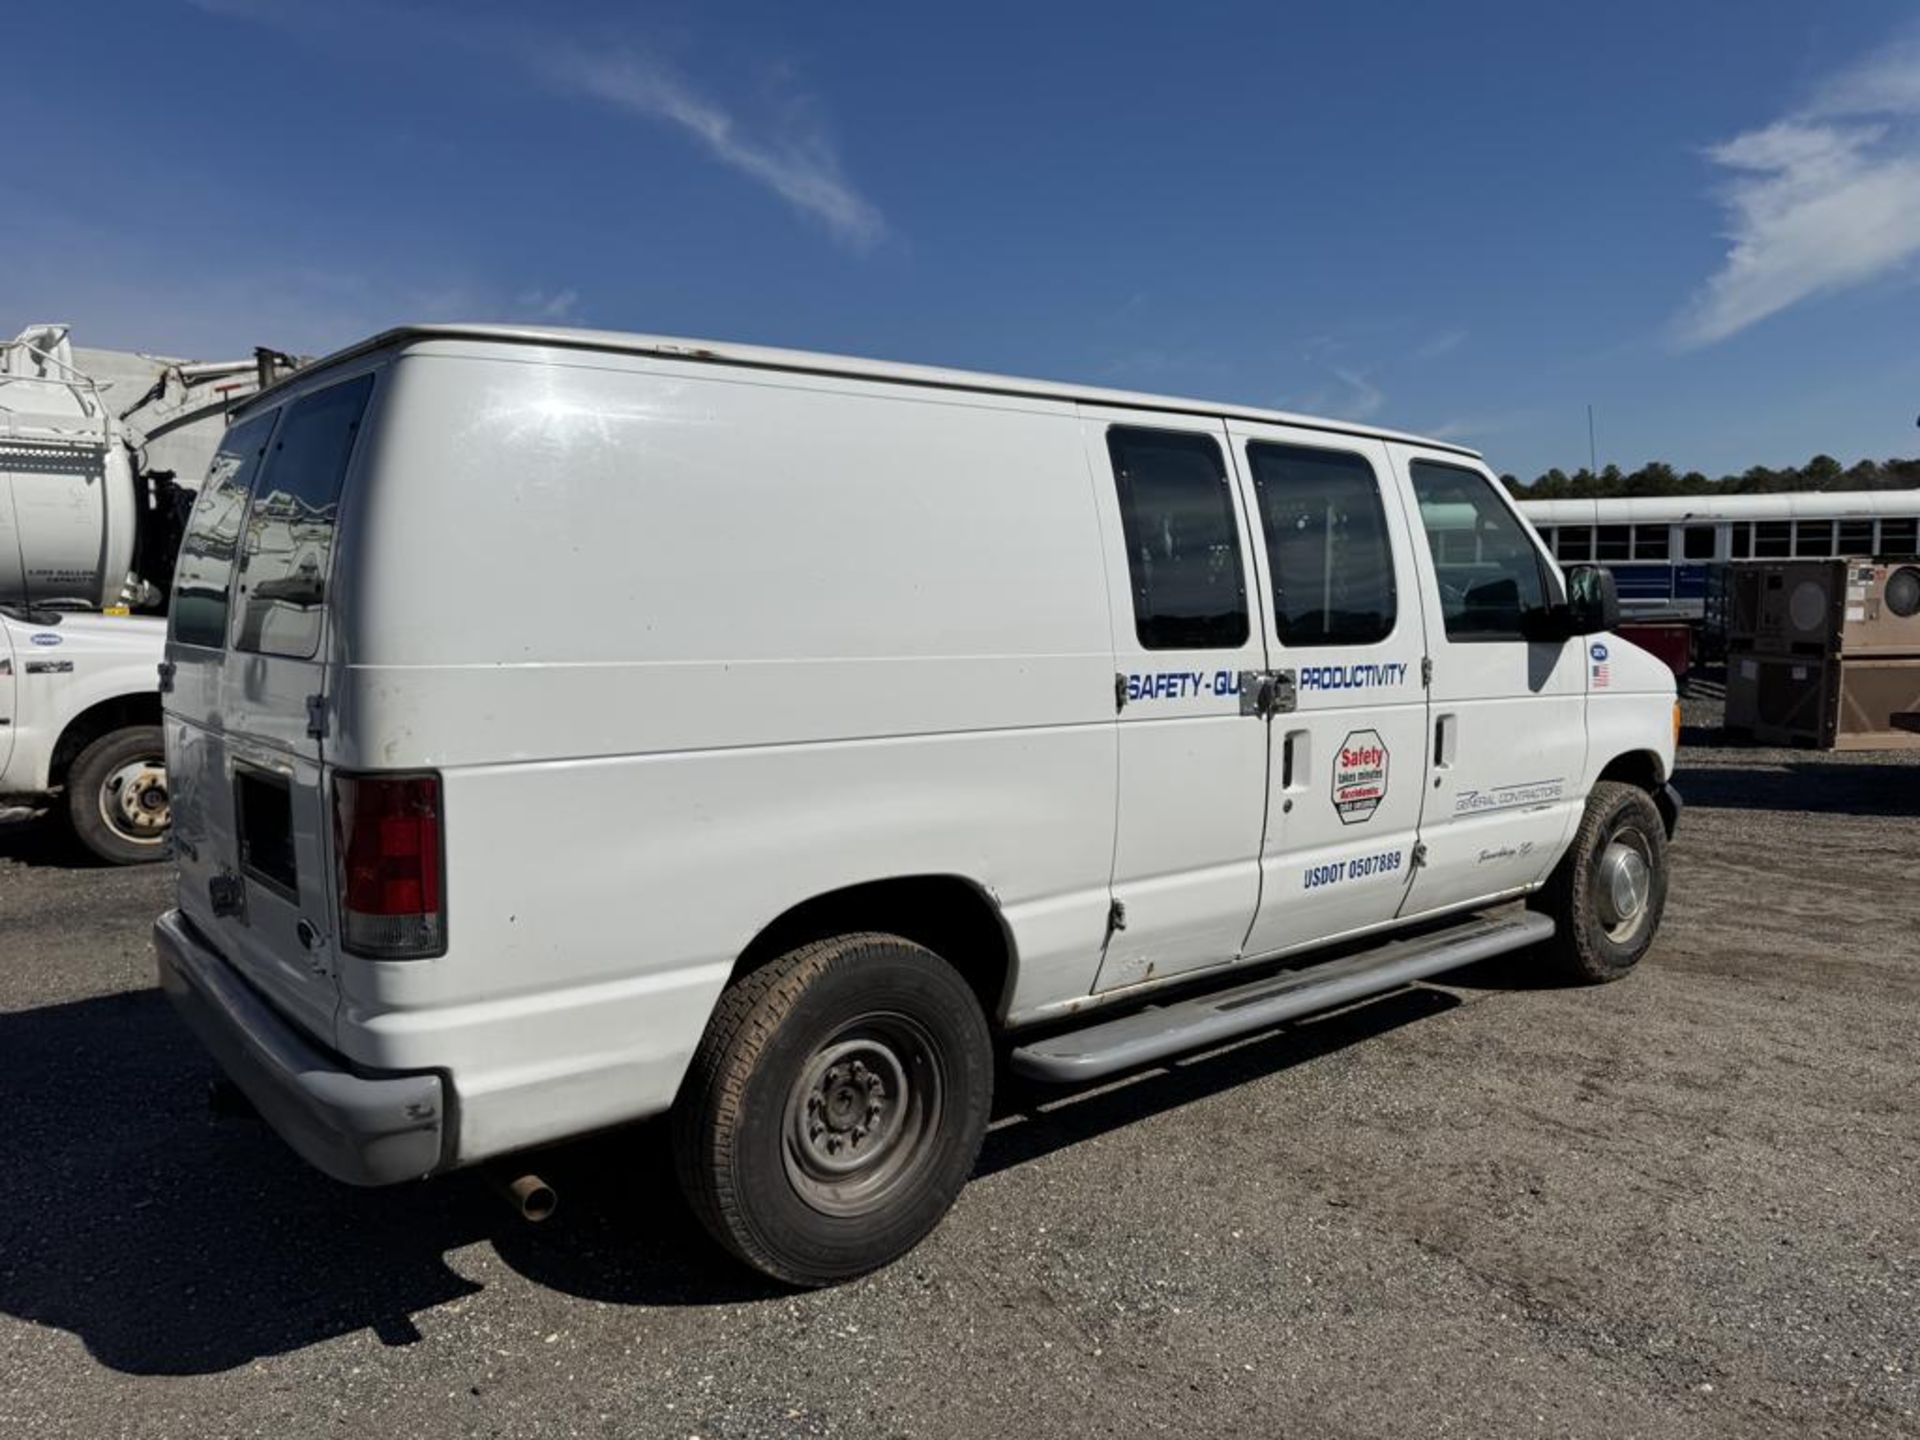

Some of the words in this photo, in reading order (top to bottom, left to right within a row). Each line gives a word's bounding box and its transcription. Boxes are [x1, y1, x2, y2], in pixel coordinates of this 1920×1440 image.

[1300, 664, 1407, 690] PRODUCTIVITY
[1341, 746, 1383, 767] Safety
[1304, 862, 1346, 889] USDOT
[1349, 851, 1401, 879] 0507889
